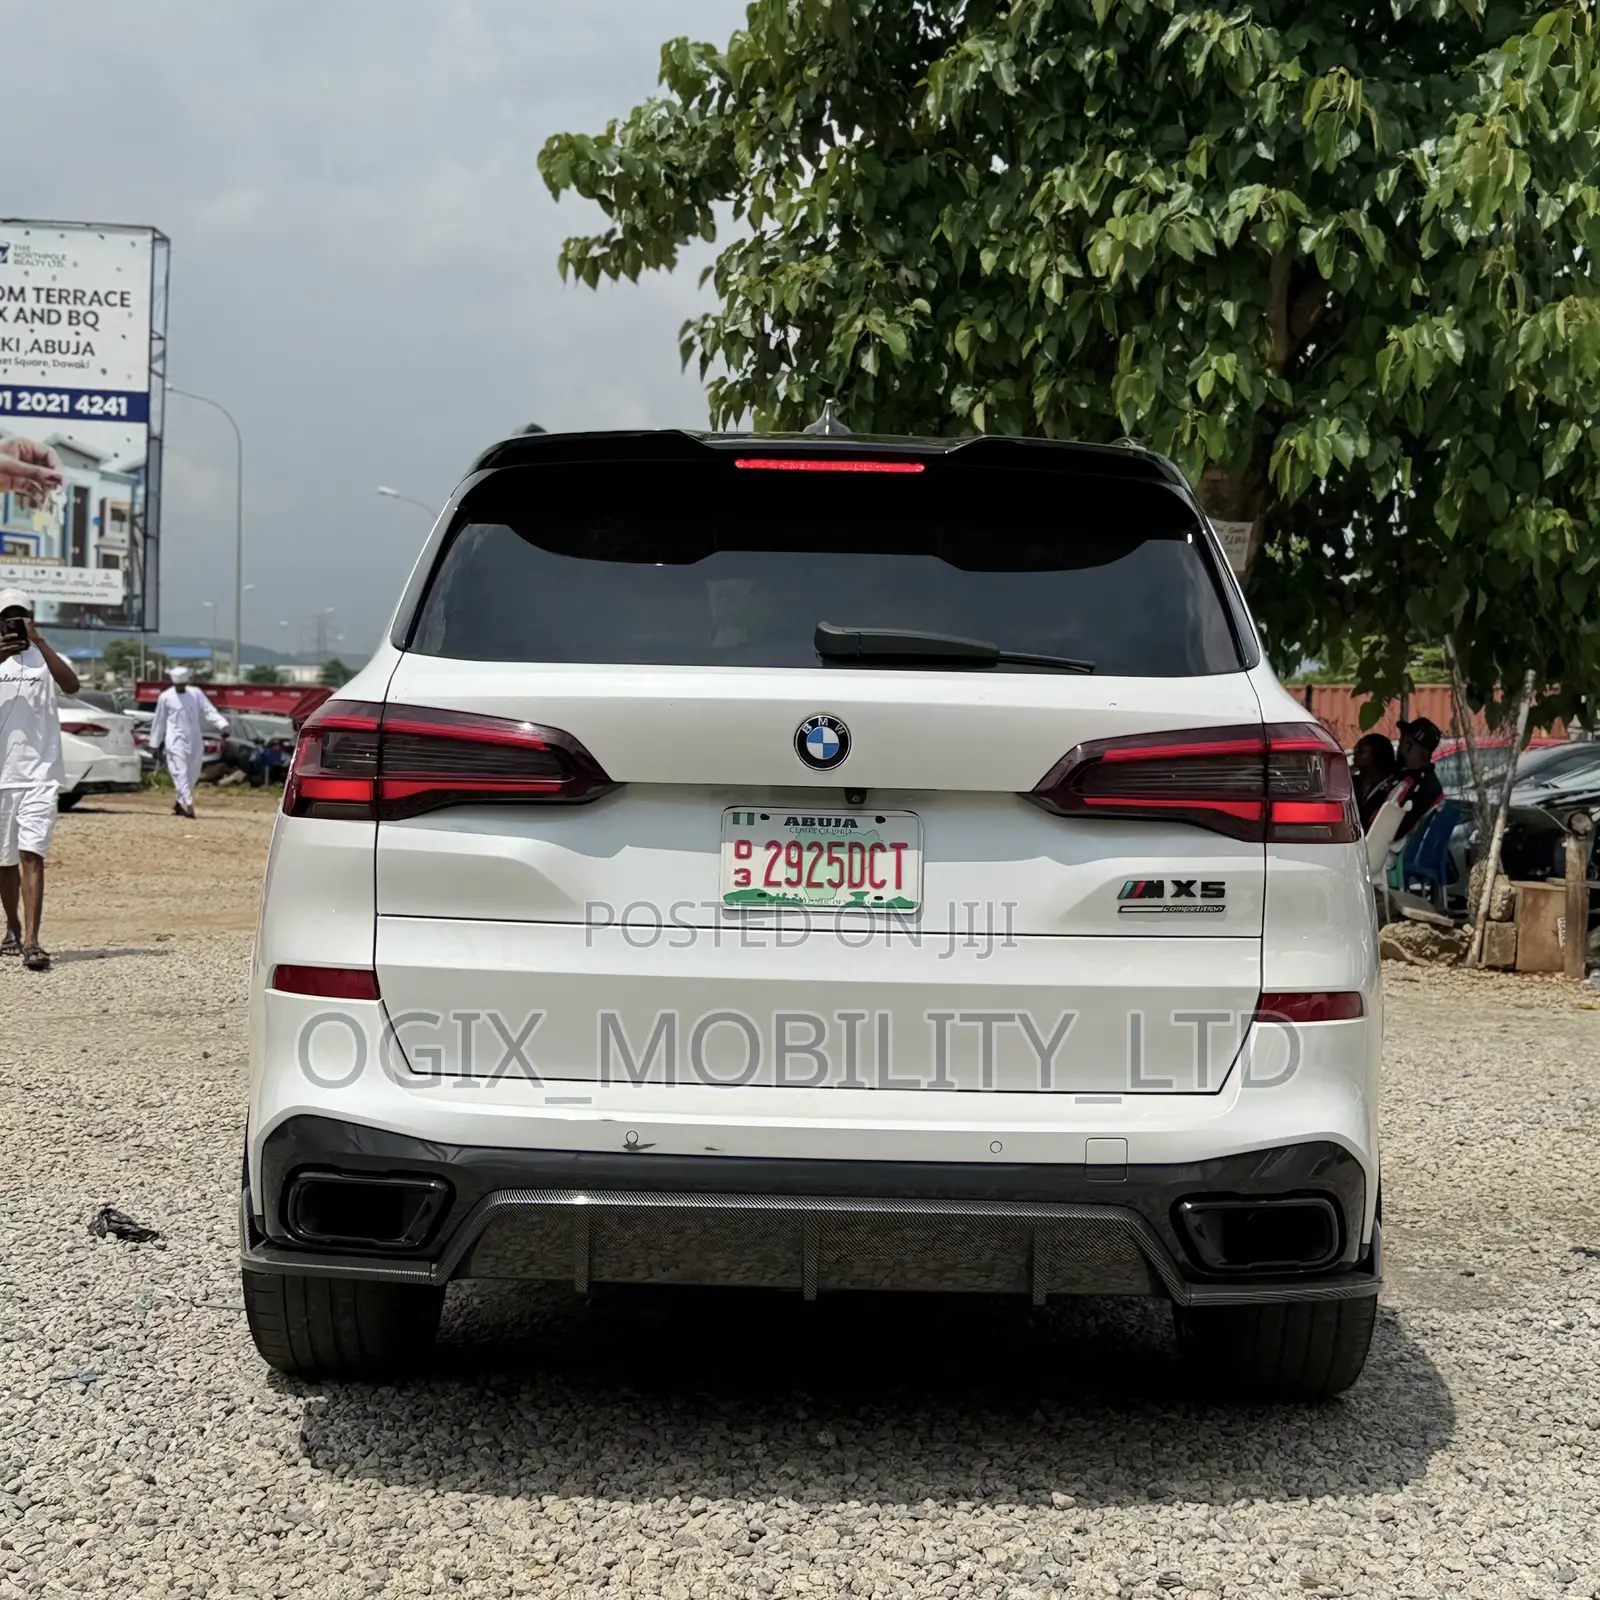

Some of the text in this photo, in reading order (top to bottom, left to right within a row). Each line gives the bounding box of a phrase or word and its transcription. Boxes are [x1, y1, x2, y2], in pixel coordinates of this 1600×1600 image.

[32, 286, 131, 308] TERRACE
[13, 306, 62, 325] AND
[67, 309, 100, 332] BQ
[16, 391, 70, 413] 2021
[74, 394, 127, 416] 4241
[802, 716, 846, 735] BMW
[784, 816, 858, 828] ABUJA
[763, 840, 908, 890] 2925DCT
